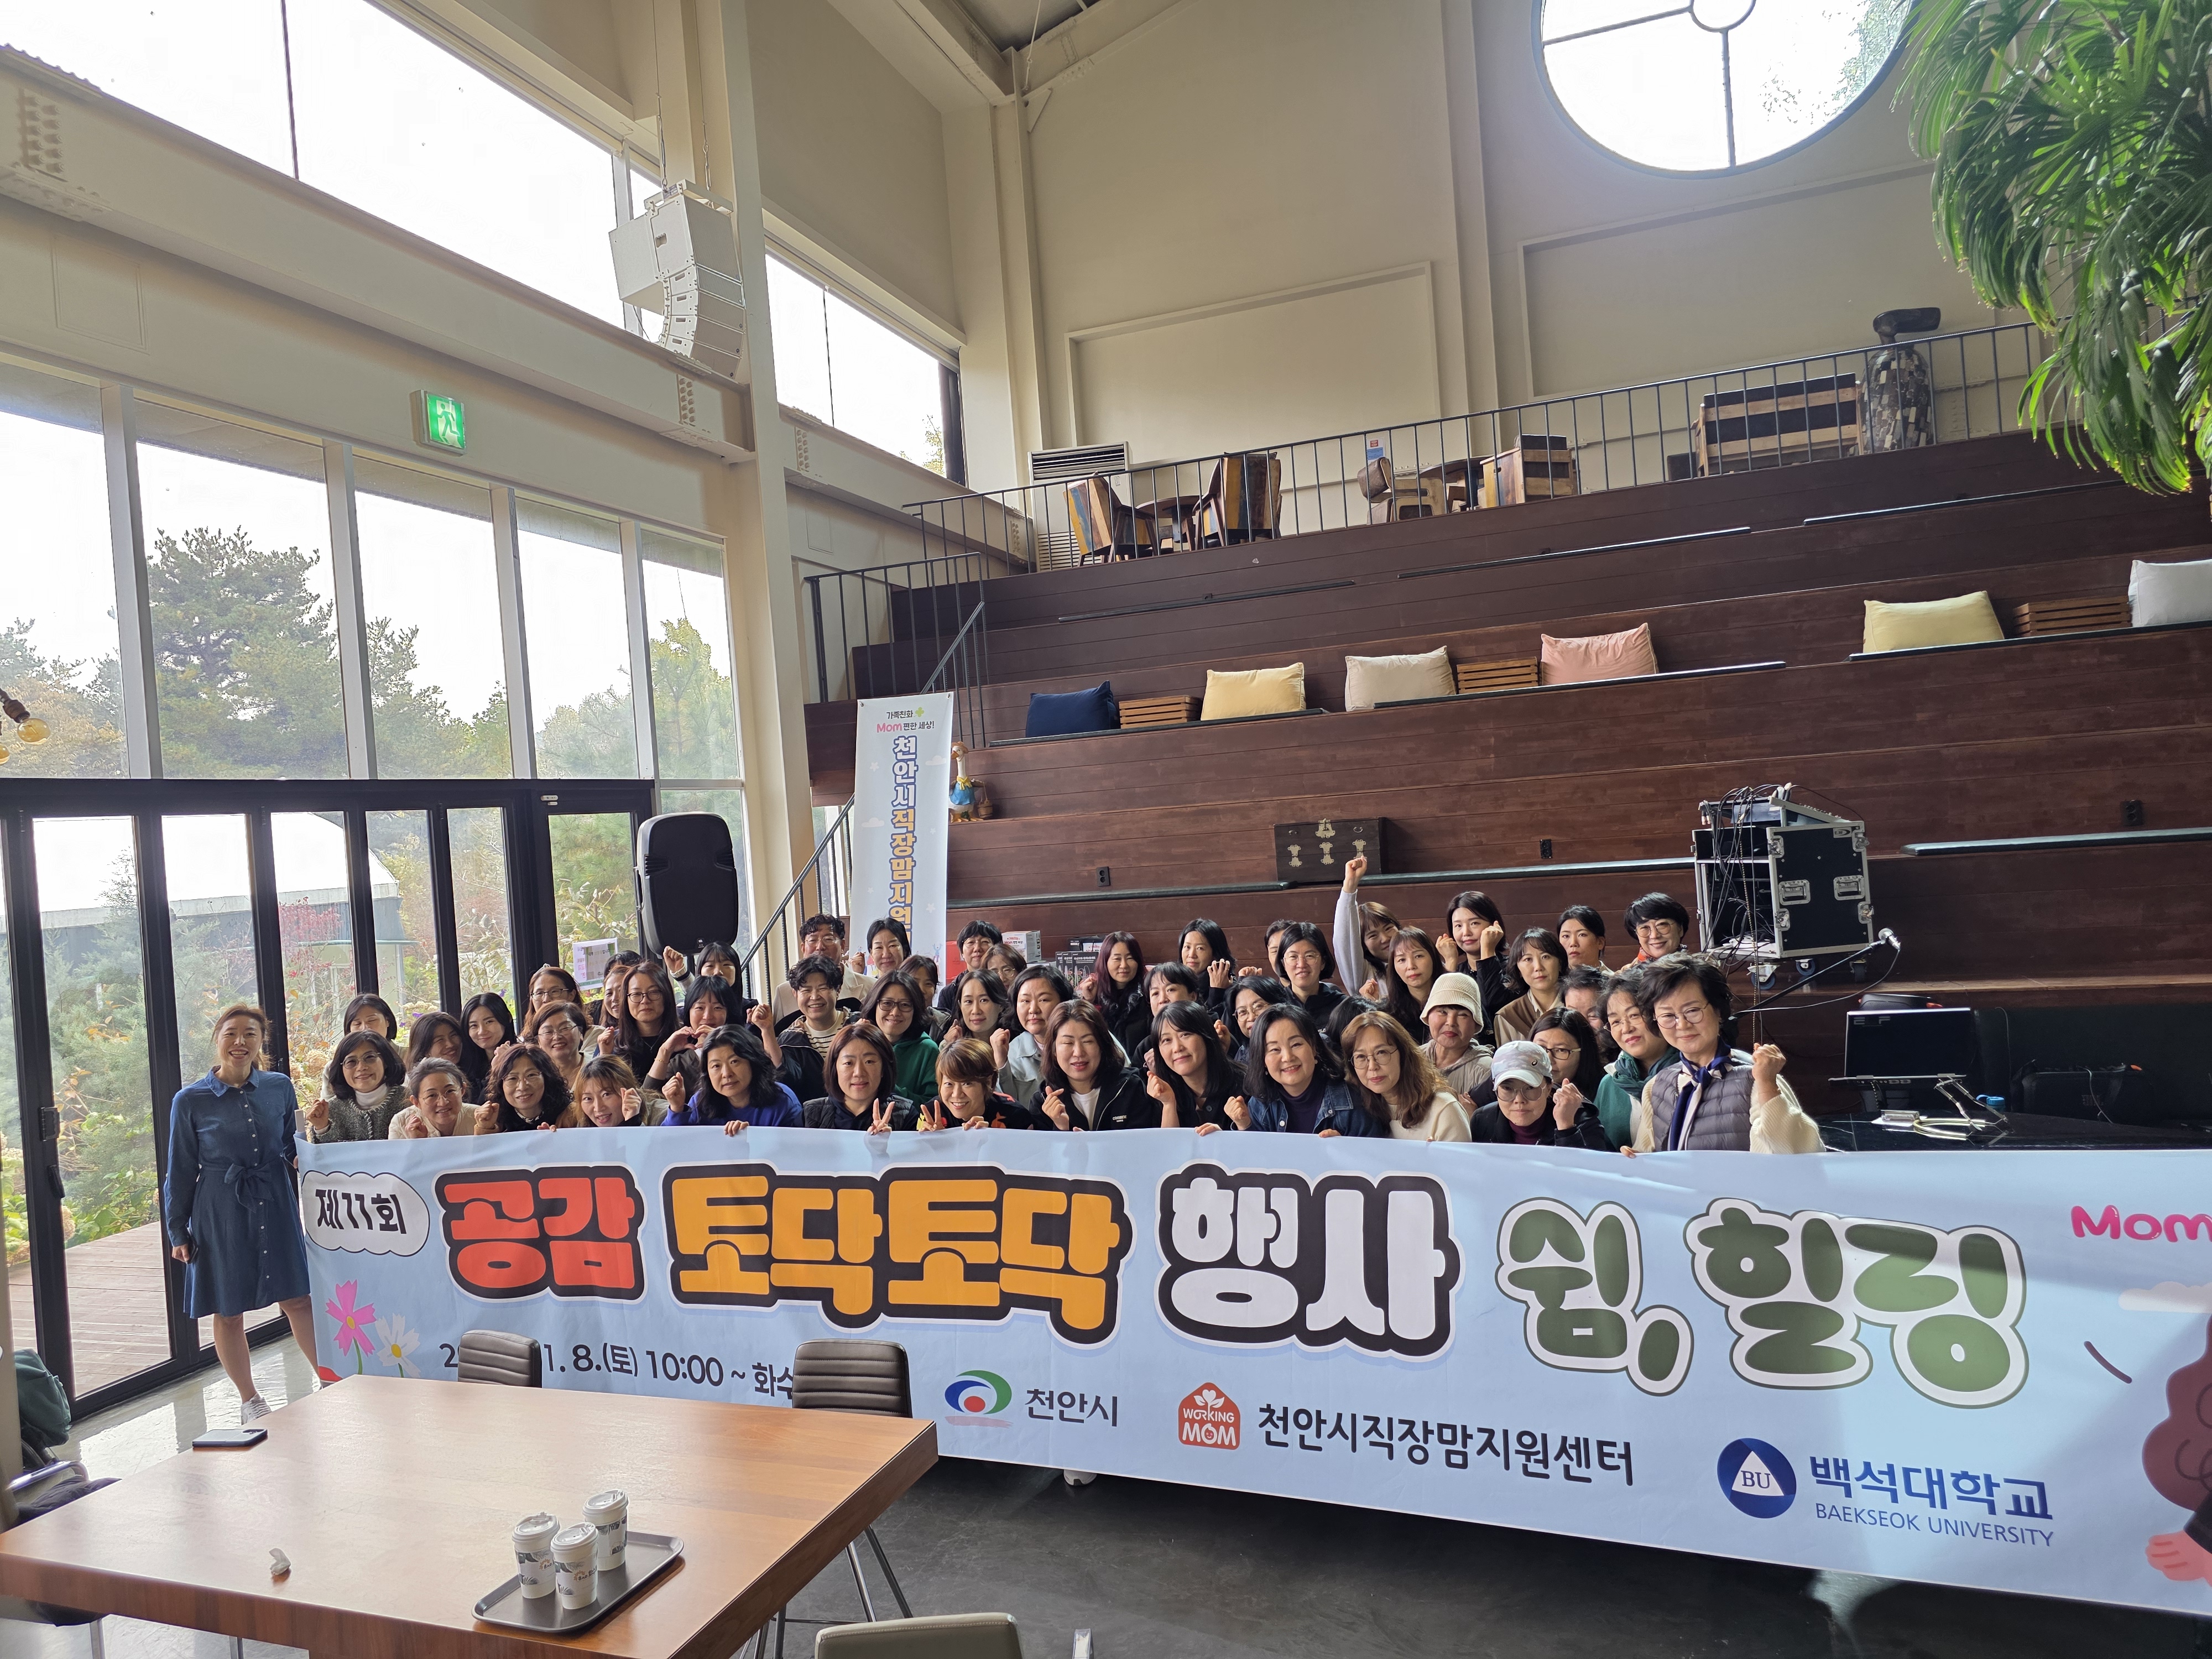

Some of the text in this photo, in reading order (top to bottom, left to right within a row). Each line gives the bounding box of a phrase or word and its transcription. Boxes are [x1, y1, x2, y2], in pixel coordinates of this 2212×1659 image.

[877, 721, 935, 733] Mom 편한 세상!
[886, 710, 913, 719] 가족친화
[315, 1189, 407, 1234] 제11회
[2070, 1204, 2212, 1243] Mom
[437, 1166, 644, 1300] 공감
[664, 1163, 1134, 1345] 토닥토닥
[1159, 1163, 1460, 1357] 행사
[1683, 1198, 2029, 1409] 힐링
[646, 1350, 723, 1387] 10:00
[1025, 1388, 1118, 1427] 천안시
[1183, 1407, 1235, 1423] WORKING
[1182, 1422, 1237, 1446] MOM
[1258, 1404, 1634, 1486] 천안시직장맘지원센터
[1740, 1470, 1771, 1489] BU
[1809, 1456, 2053, 1520] 백석대학교
[1815, 1503, 2054, 1547] BAEKSEOK UNIVERSITY
